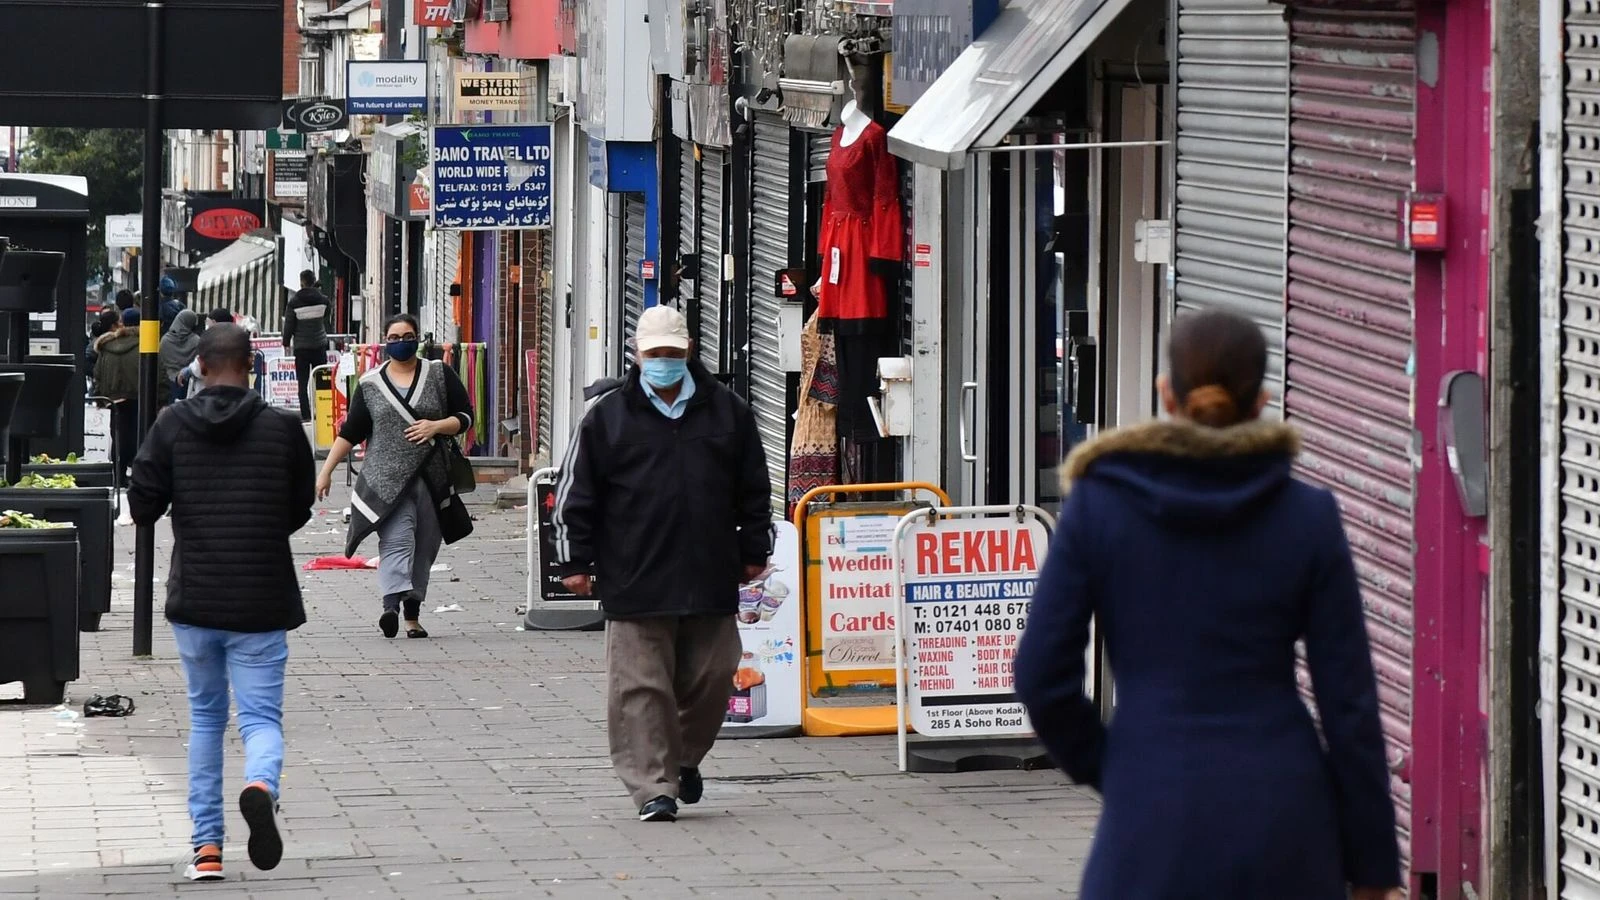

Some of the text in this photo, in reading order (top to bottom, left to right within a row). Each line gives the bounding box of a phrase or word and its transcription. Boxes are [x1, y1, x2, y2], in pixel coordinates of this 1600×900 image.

[376, 75, 418, 85] modality
[461, 79, 520, 88] WESTERN
[480, 88, 520, 96] UNION
[308, 109, 336, 123] Kyles
[435, 145, 550, 161] BAMO TRAVEL LTD
[438, 166, 473, 178] WORLD
[476, 166, 501, 178] WIDE
[439, 183, 479, 192] TEL/FAX:
[481, 183, 502, 191] 0121
[524, 182, 546, 191] 5347
[916, 528, 1037, 575] REKHA
[913, 585, 941, 600] HAIR
[944, 584, 954, 599] &
[956, 582, 1000, 598] BEAUTY
[913, 606, 927, 618] T:
[933, 605, 967, 618] 0121
[974, 603, 1000, 616] 448
[830, 611, 895, 632] Cards
[914, 621, 930, 634] M:
[935, 620, 979, 633] 07401
[985, 618, 1011, 631] 080
[918, 636, 967, 649] THREADING
[977, 634, 1016, 647] MAKE UP
[828, 643, 881, 663] Direct
[918, 650, 954, 663] WAXING
[977, 649, 1000, 660] BODY
[919, 664, 949, 677] FACIAL
[978, 662, 999, 674] HAIR
[919, 678, 955, 691] MEHNDI
[978, 676, 1015, 688] HAIR UP
[926, 706, 1027, 717] 1st Floor (Above Kodak)
[931, 717, 1023, 729] 285 A Soho Road
